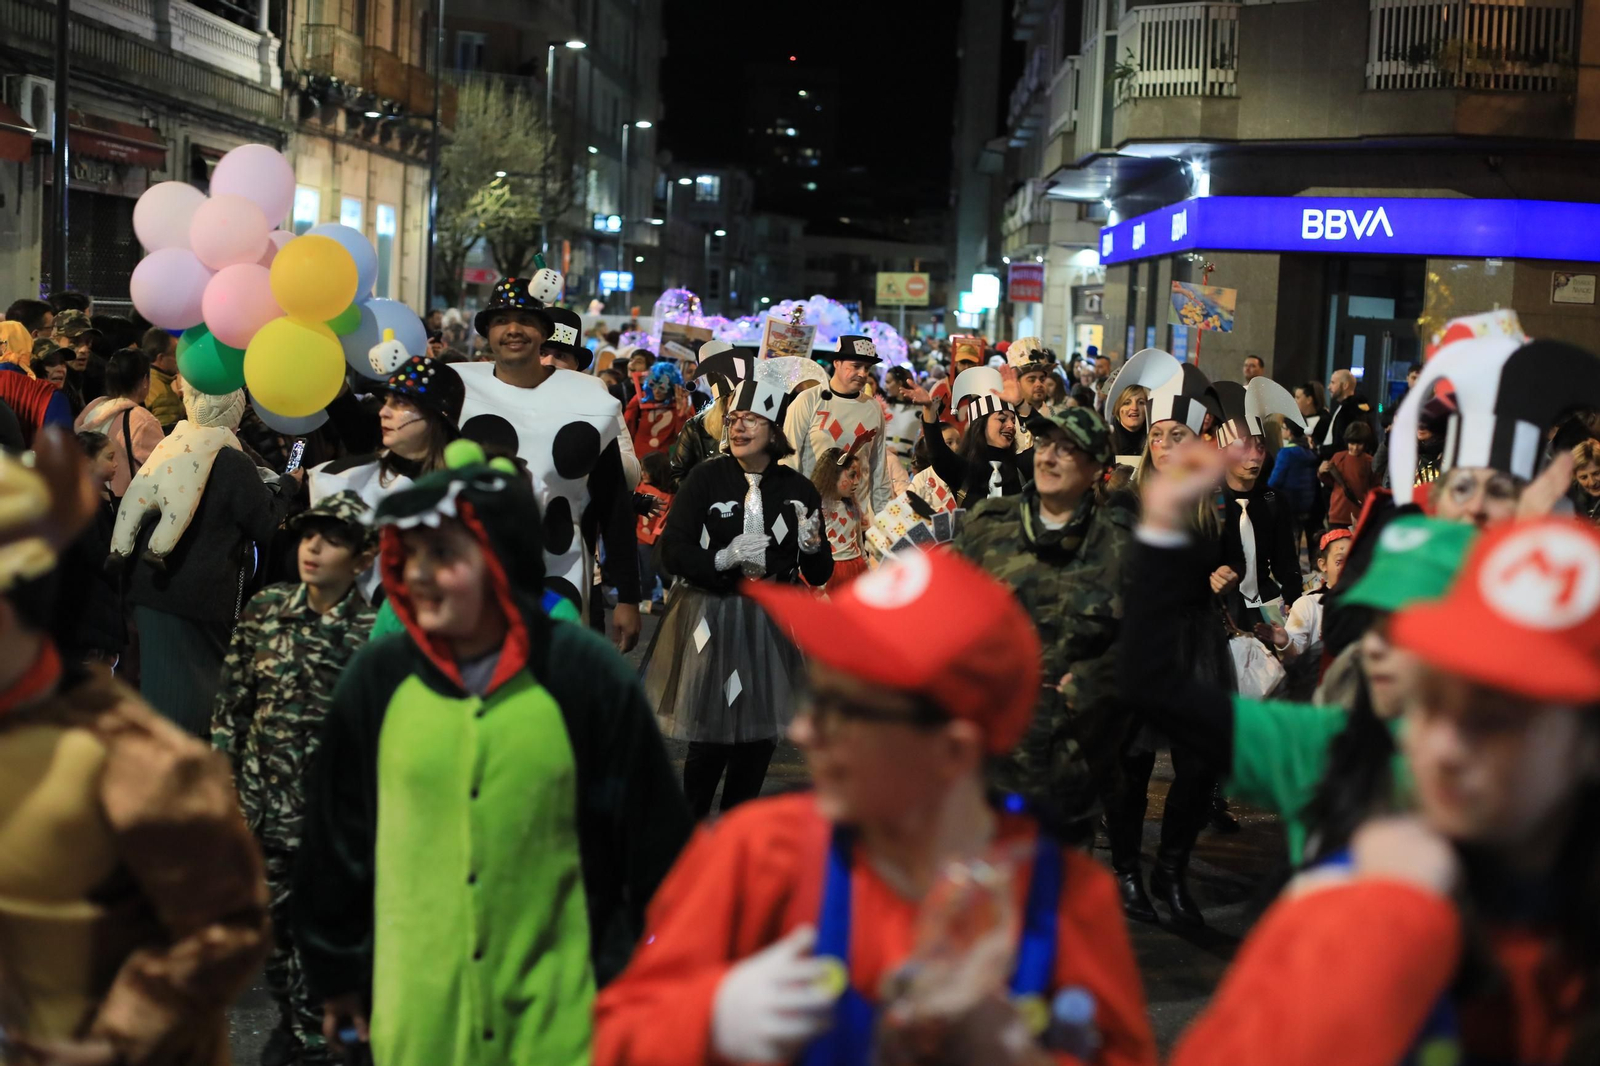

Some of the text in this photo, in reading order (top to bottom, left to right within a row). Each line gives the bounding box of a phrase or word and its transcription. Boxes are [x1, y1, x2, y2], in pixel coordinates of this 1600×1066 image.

[1301, 206, 1394, 240] BBVA
[816, 411, 830, 431] 7
[1499, 546, 1579, 608] M
